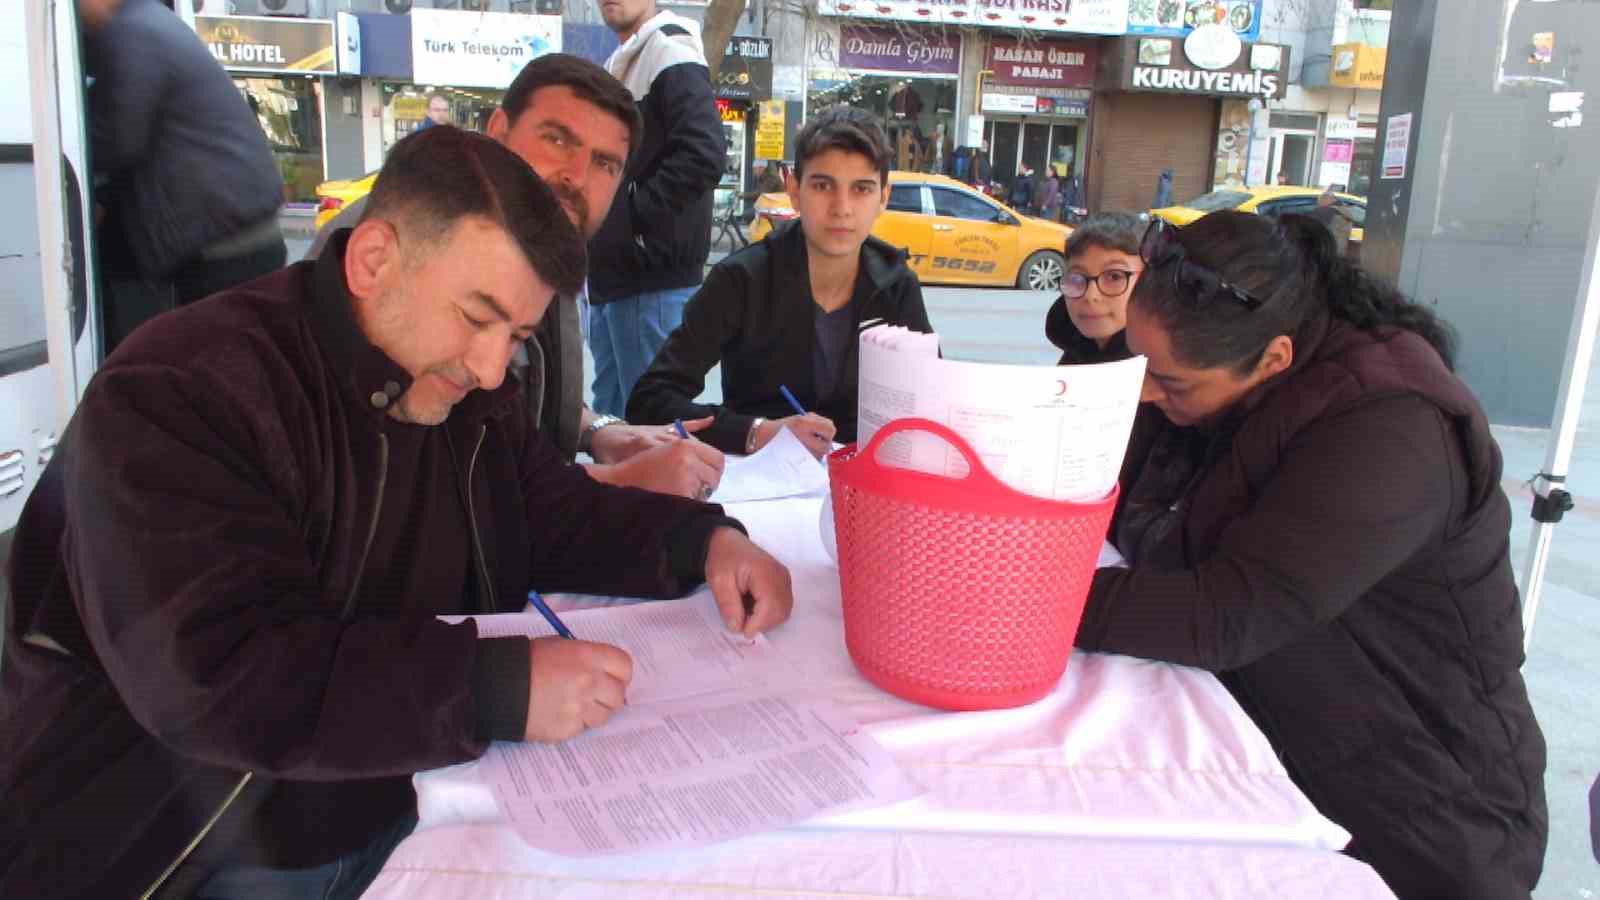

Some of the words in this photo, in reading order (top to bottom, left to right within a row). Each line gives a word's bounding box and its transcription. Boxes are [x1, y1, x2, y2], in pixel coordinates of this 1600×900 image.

[230, 44, 286, 63] HOTEL
[423, 39, 456, 53] Türk
[461, 41, 524, 56] Telekom
[846, 38, 901, 57] Damla
[906, 38, 954, 64] Giyim
[993, 47, 1043, 63] HASAN
[1047, 47, 1086, 65] ÖREN
[1133, 66, 1279, 98] KURUYEMİŞ
